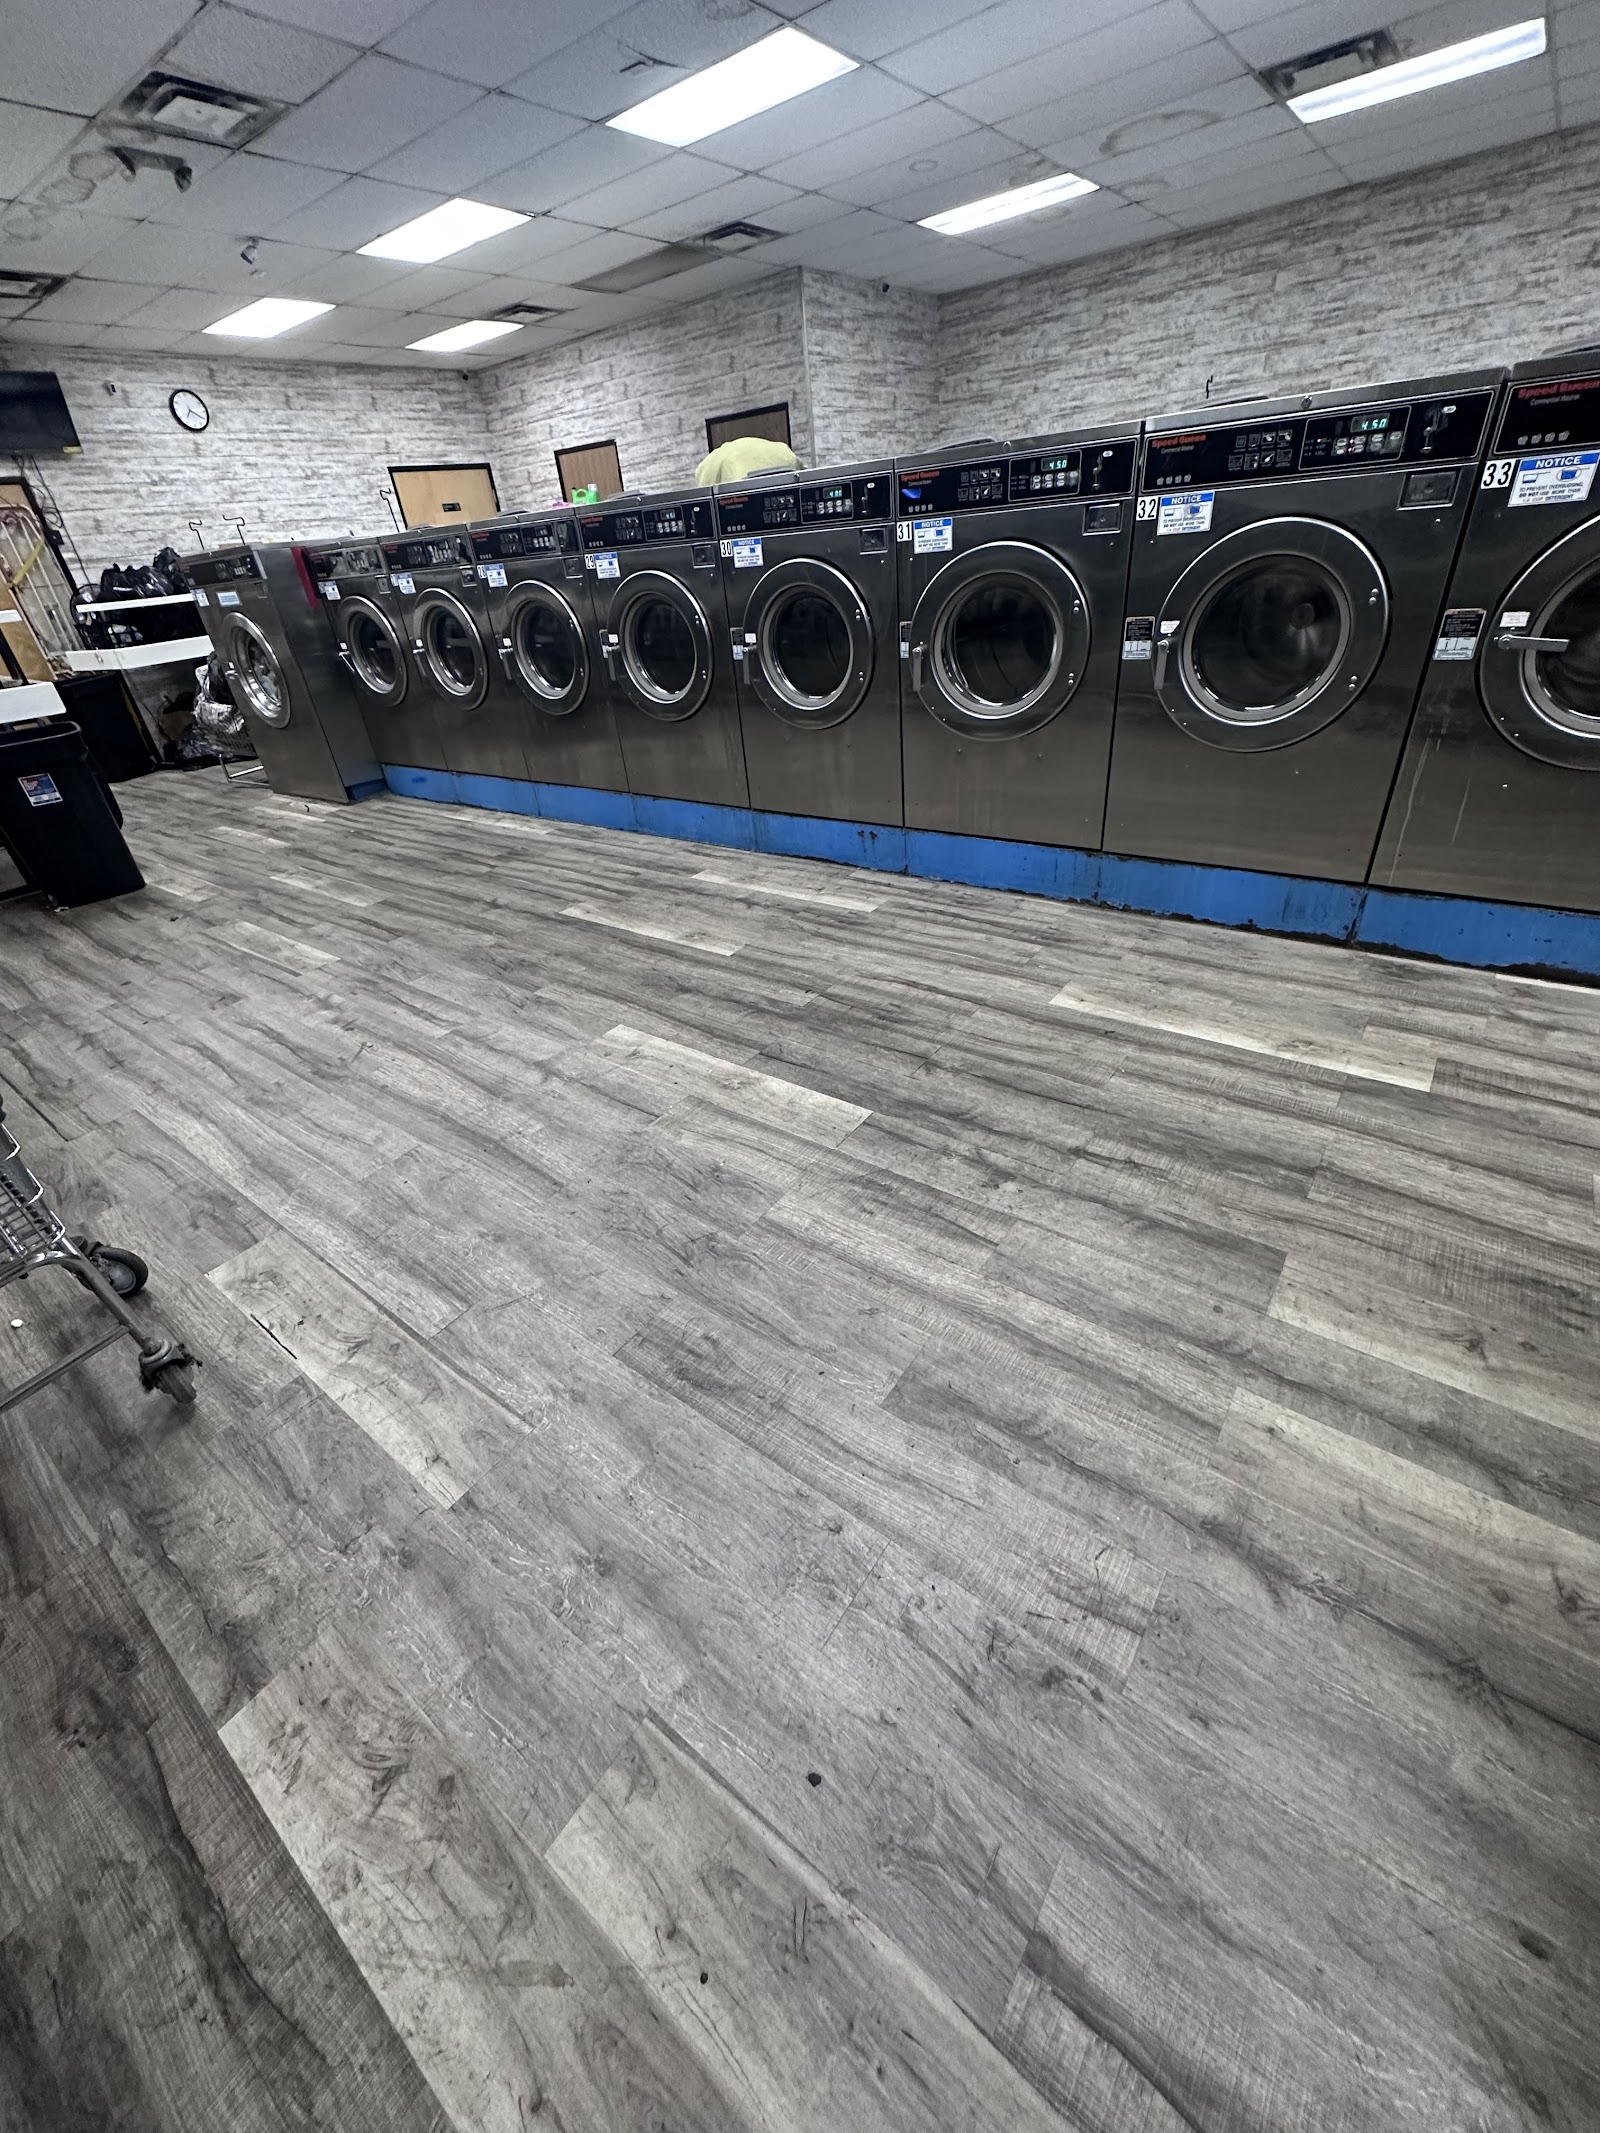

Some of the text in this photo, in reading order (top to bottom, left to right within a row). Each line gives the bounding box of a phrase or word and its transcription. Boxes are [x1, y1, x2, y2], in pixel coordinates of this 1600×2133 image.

[1518, 384, 1558, 399] Speed
[1535, 456, 1582, 468] NOTICE
[1483, 462, 1512, 487] 33
[1171, 495, 1202, 505] NOTICE
[1138, 499, 1156, 519] 32
[921, 519, 943, 528] NOTICE
[898, 523, 911, 540] 31
[721, 541, 732, 556] 30
